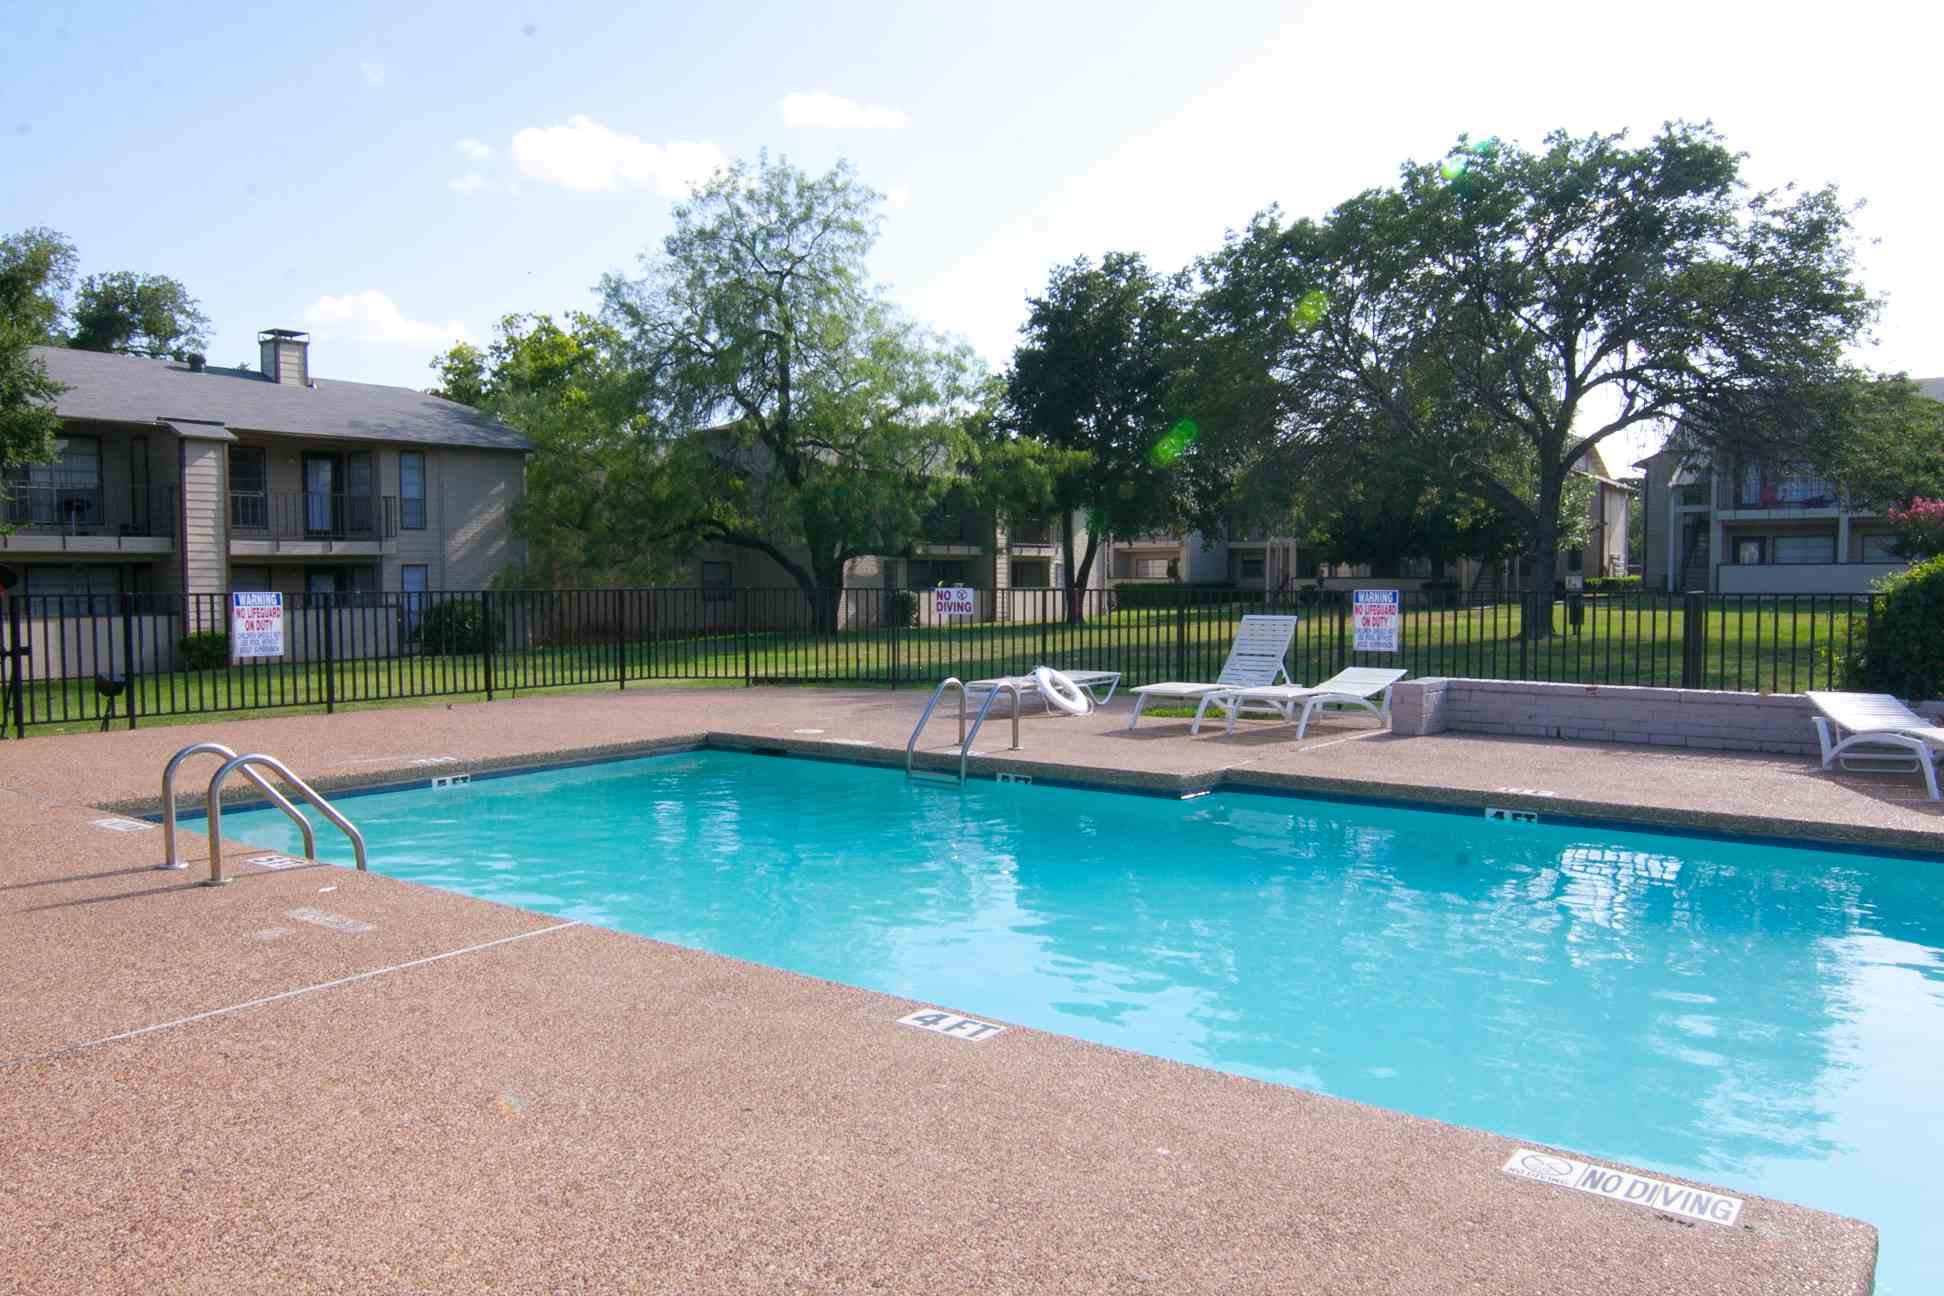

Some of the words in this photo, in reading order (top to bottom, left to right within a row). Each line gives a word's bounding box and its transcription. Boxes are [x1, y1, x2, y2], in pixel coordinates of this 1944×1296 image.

[239, 592, 277, 606] WARNING
[935, 590, 951, 601] NO
[1358, 591, 1393, 603] WARNING
[235, 607, 246, 619] NO
[248, 607, 281, 618] LIFEGUARD
[936, 602, 972, 613] DIVING
[1355, 604, 1363, 615] NO
[1364, 604, 1396, 615] LIFEGUARD
[245, 619, 255, 631] ON
[256, 619, 273, 631] DUTY
[1361, 616, 1371, 627] ON
[1372, 616, 1389, 627] DUTY
[1581, 1168, 1623, 1194] NO
[1624, 1179, 1735, 1221] DIVING
